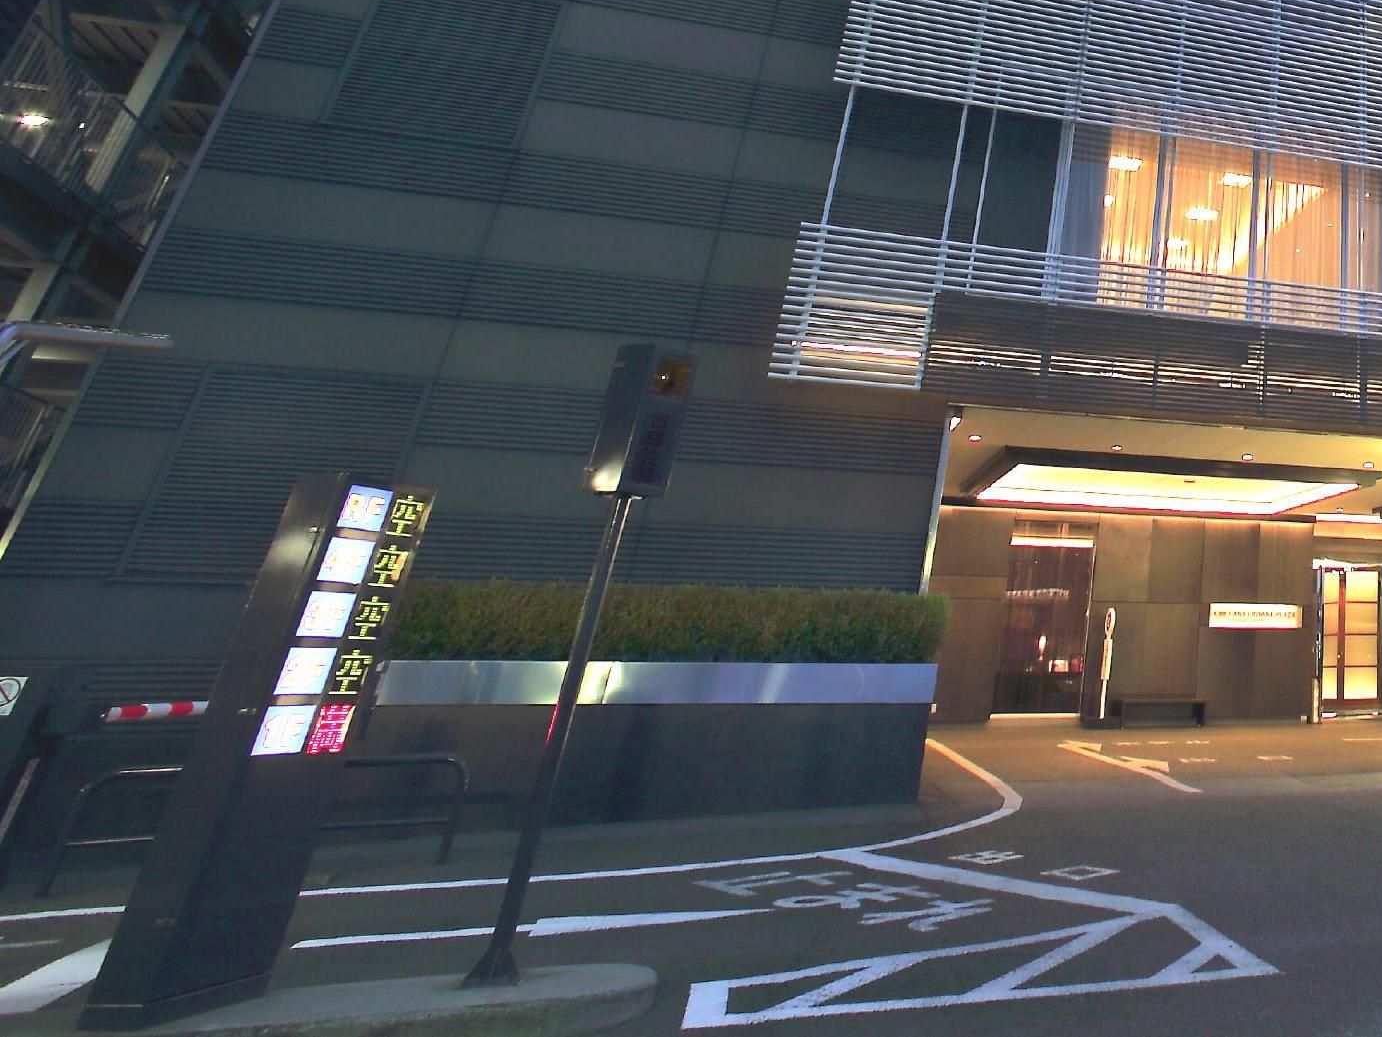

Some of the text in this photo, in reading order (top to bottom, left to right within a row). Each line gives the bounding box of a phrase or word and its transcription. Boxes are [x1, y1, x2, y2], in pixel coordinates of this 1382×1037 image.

[385, 495, 425, 537] 空
[368, 544, 404, 588] 空
[348, 595, 391, 641] 空
[328, 649, 373, 695] 空
